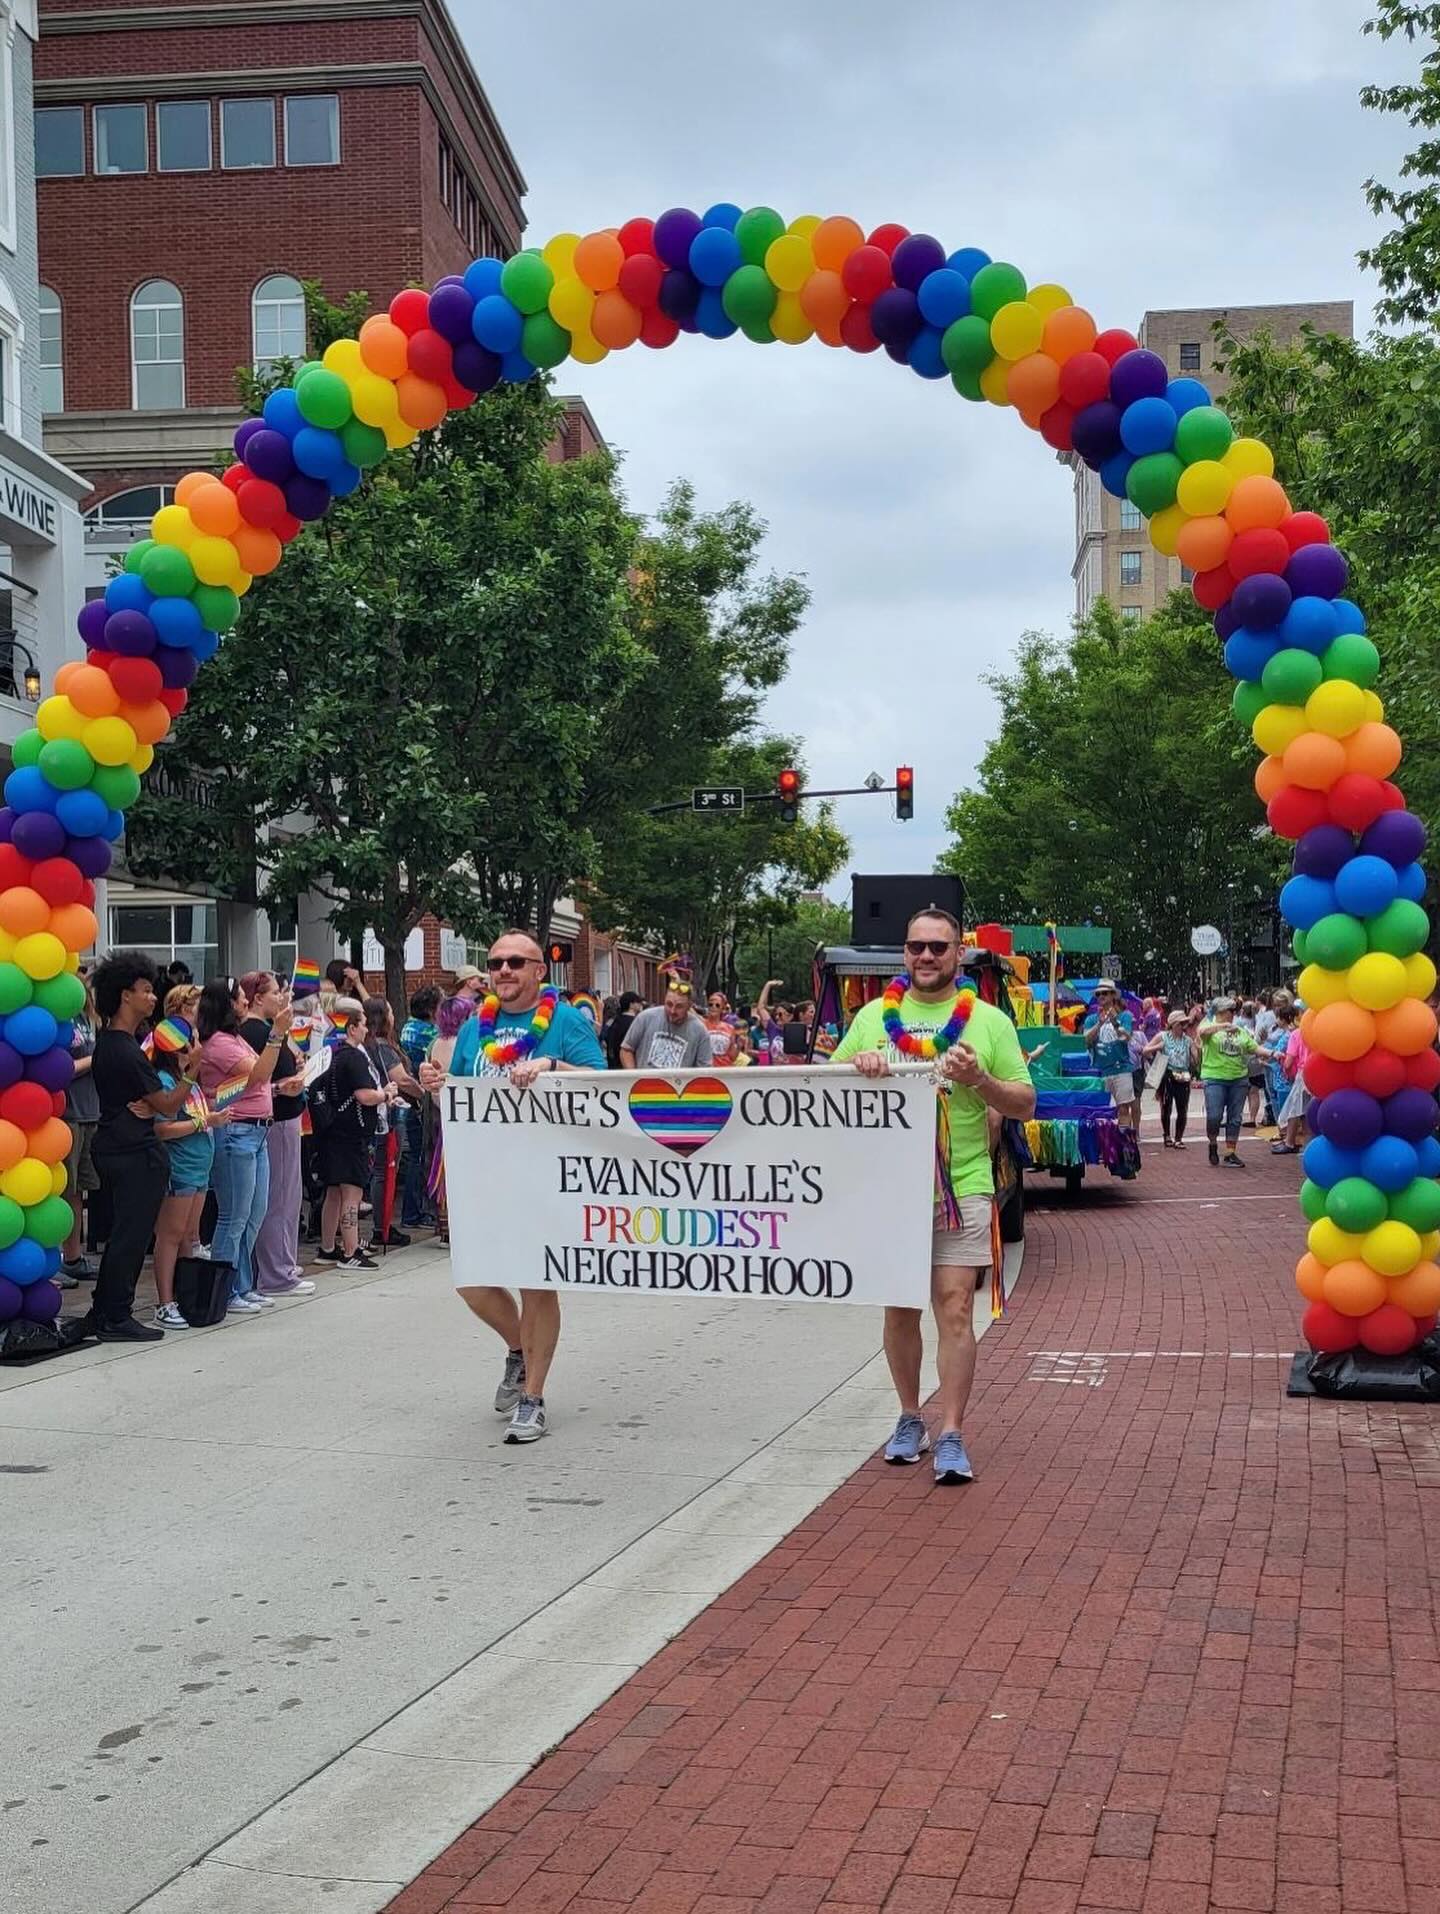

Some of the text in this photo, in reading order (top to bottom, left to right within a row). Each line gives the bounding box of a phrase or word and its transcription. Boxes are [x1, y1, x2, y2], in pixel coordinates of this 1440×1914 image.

[4, 478, 55, 536] WINE
[722, 793, 736, 805] St
[449, 1085, 911, 1130] HAYNIE'S CORNER
[559, 1157, 823, 1204] EVANSVILLE'S
[583, 1205, 788, 1250] PROUDEST
[544, 1246, 852, 1298] NEIGHBORHOOD
